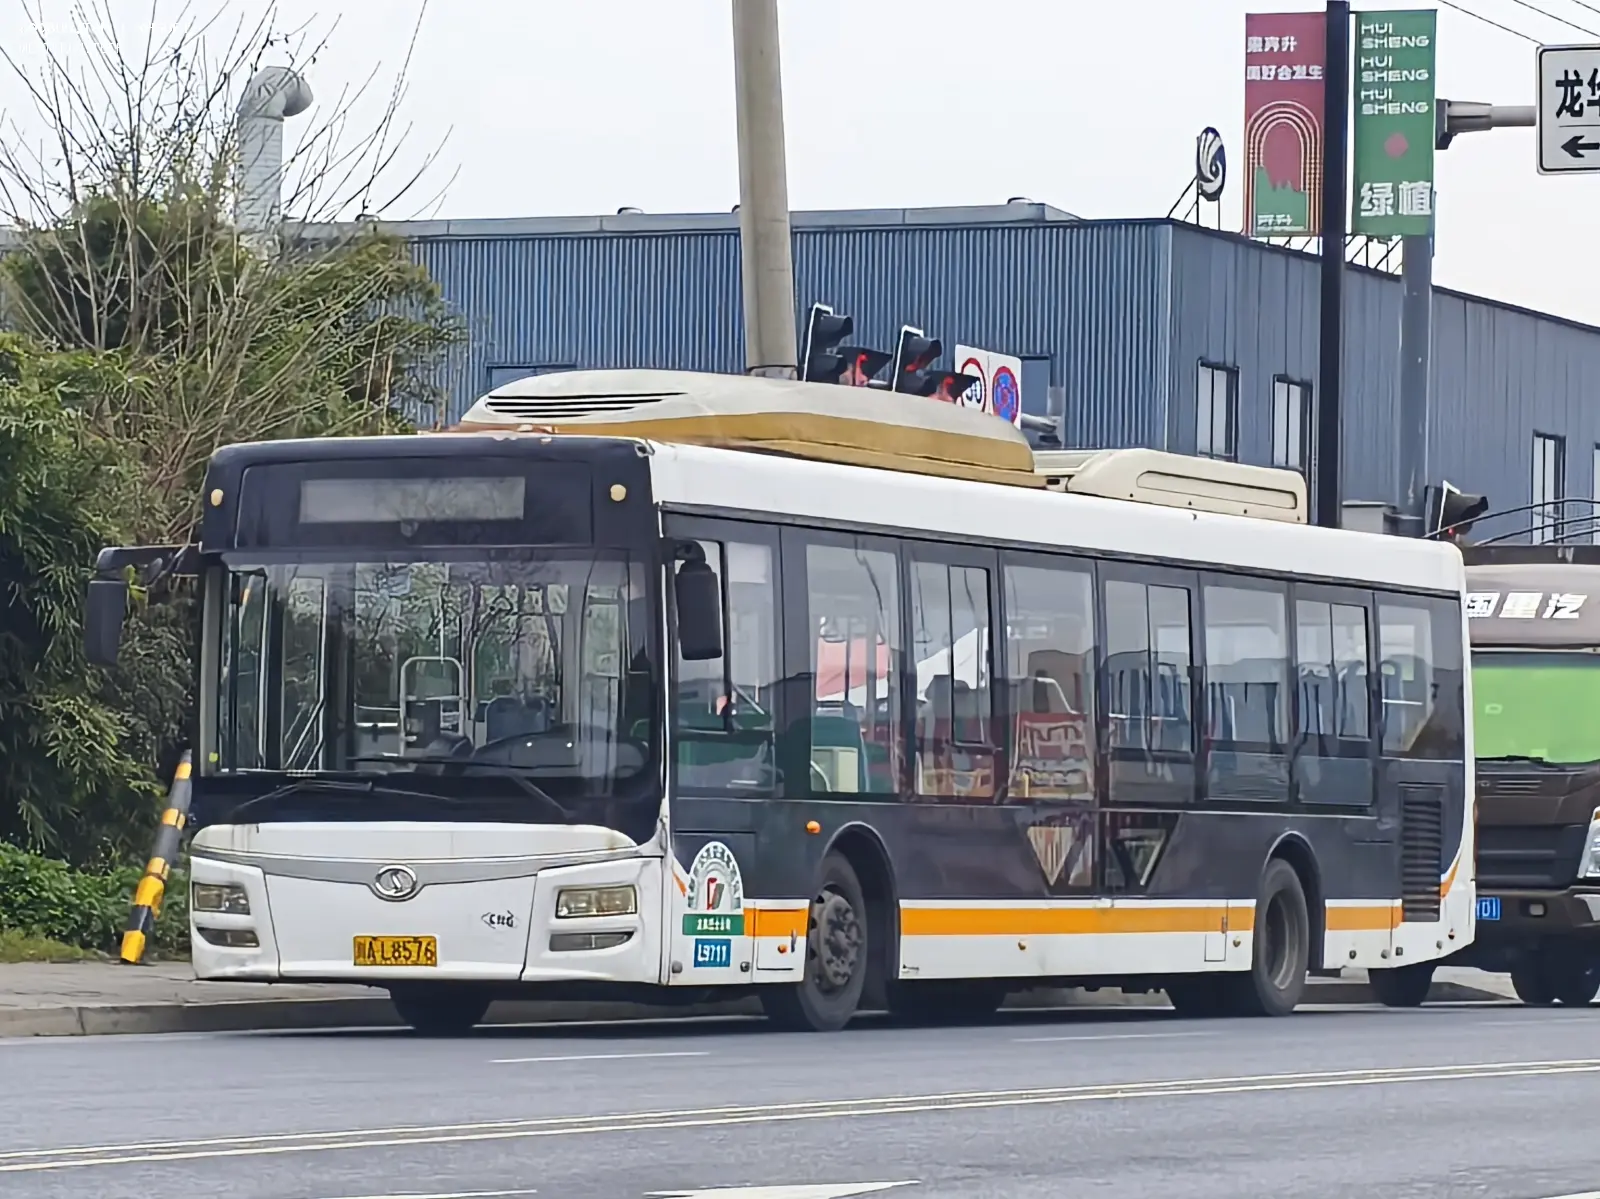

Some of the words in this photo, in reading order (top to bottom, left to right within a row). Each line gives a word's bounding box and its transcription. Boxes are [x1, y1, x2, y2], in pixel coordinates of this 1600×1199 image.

[1361, 22, 1393, 35] HUI
[1362, 35, 1430, 49] SHENG
[1361, 55, 1393, 69] HUI
[1362, 69, 1429, 83] SHENG
[1361, 88, 1393, 101] HUI
[1362, 101, 1429, 115] SHENG
[1360, 181, 1432, 217] 绿植
